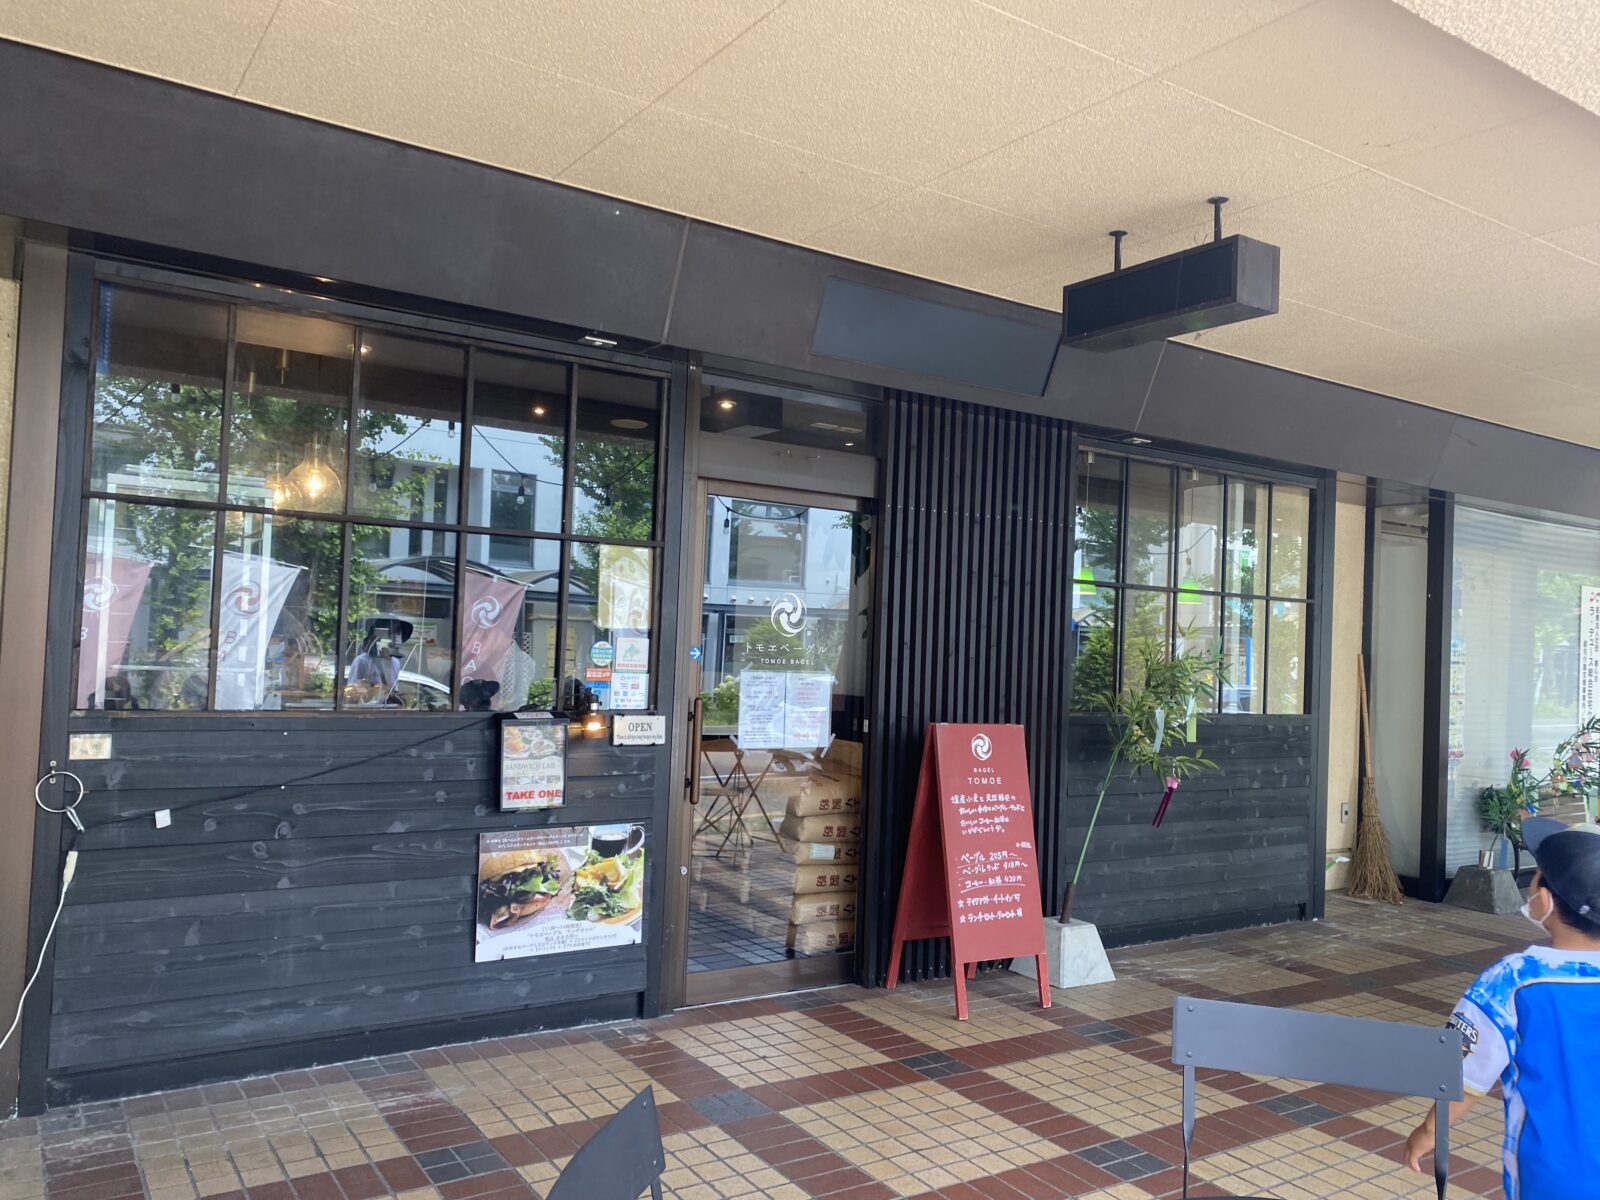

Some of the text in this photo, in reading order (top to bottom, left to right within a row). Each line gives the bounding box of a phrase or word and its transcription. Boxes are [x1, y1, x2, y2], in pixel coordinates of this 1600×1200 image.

[628, 722, 653, 732] OPEN
[967, 777, 1003, 785] TOMOE
[506, 789, 561, 801] TAKE ONE
